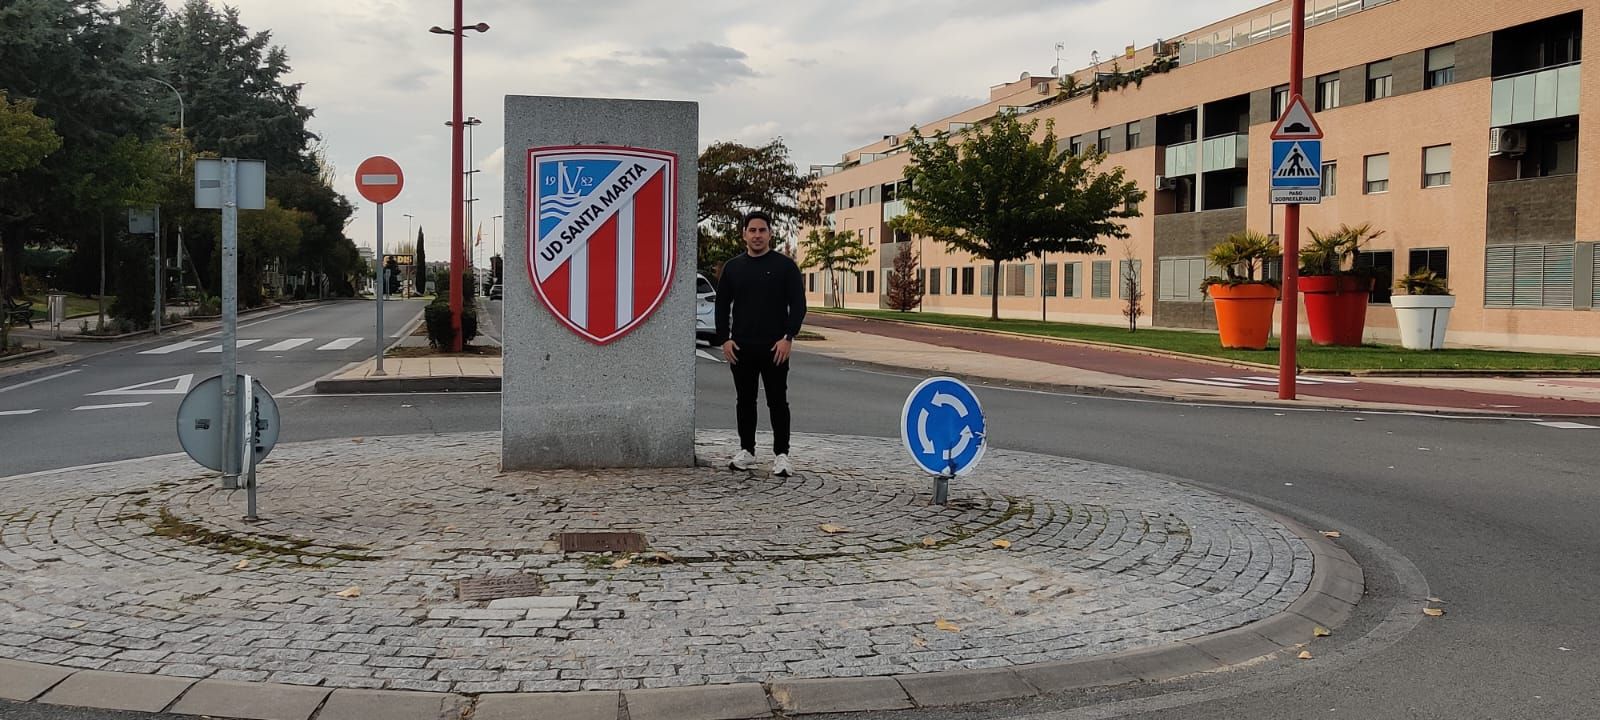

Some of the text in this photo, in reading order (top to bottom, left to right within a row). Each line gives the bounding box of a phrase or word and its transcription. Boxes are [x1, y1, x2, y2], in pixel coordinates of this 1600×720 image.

[545, 175, 556, 186] 19
[581, 176, 593, 187] 82
[540, 163, 648, 262] UD SANTA MARTA
